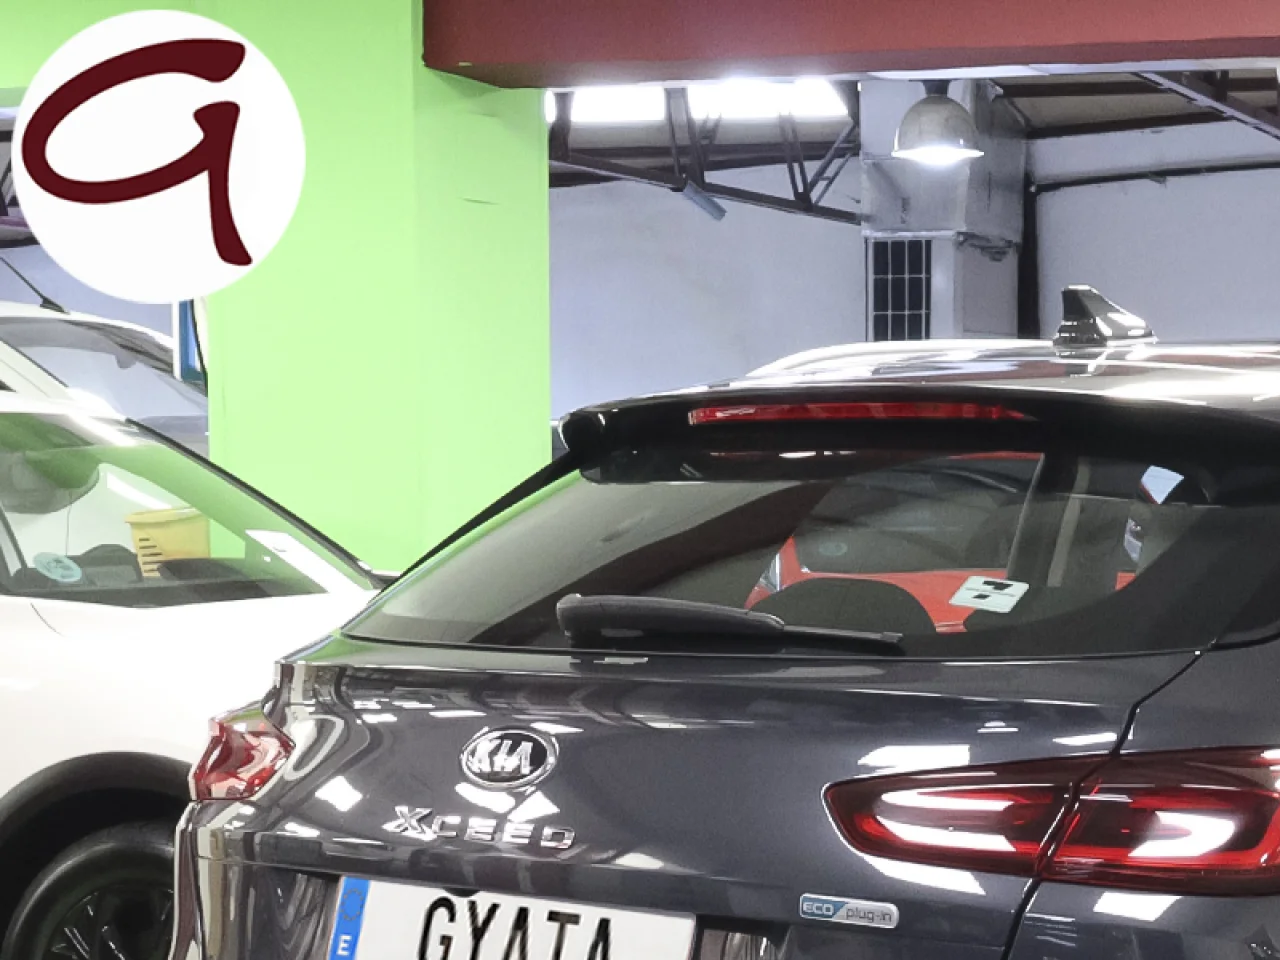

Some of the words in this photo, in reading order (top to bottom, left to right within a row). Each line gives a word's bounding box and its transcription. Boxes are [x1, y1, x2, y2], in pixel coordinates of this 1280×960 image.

[466, 739, 534, 775] KIA
[803, 902, 834, 915] ECO
[846, 906, 892, 923] plug-in
[337, 935, 351, 956] E
